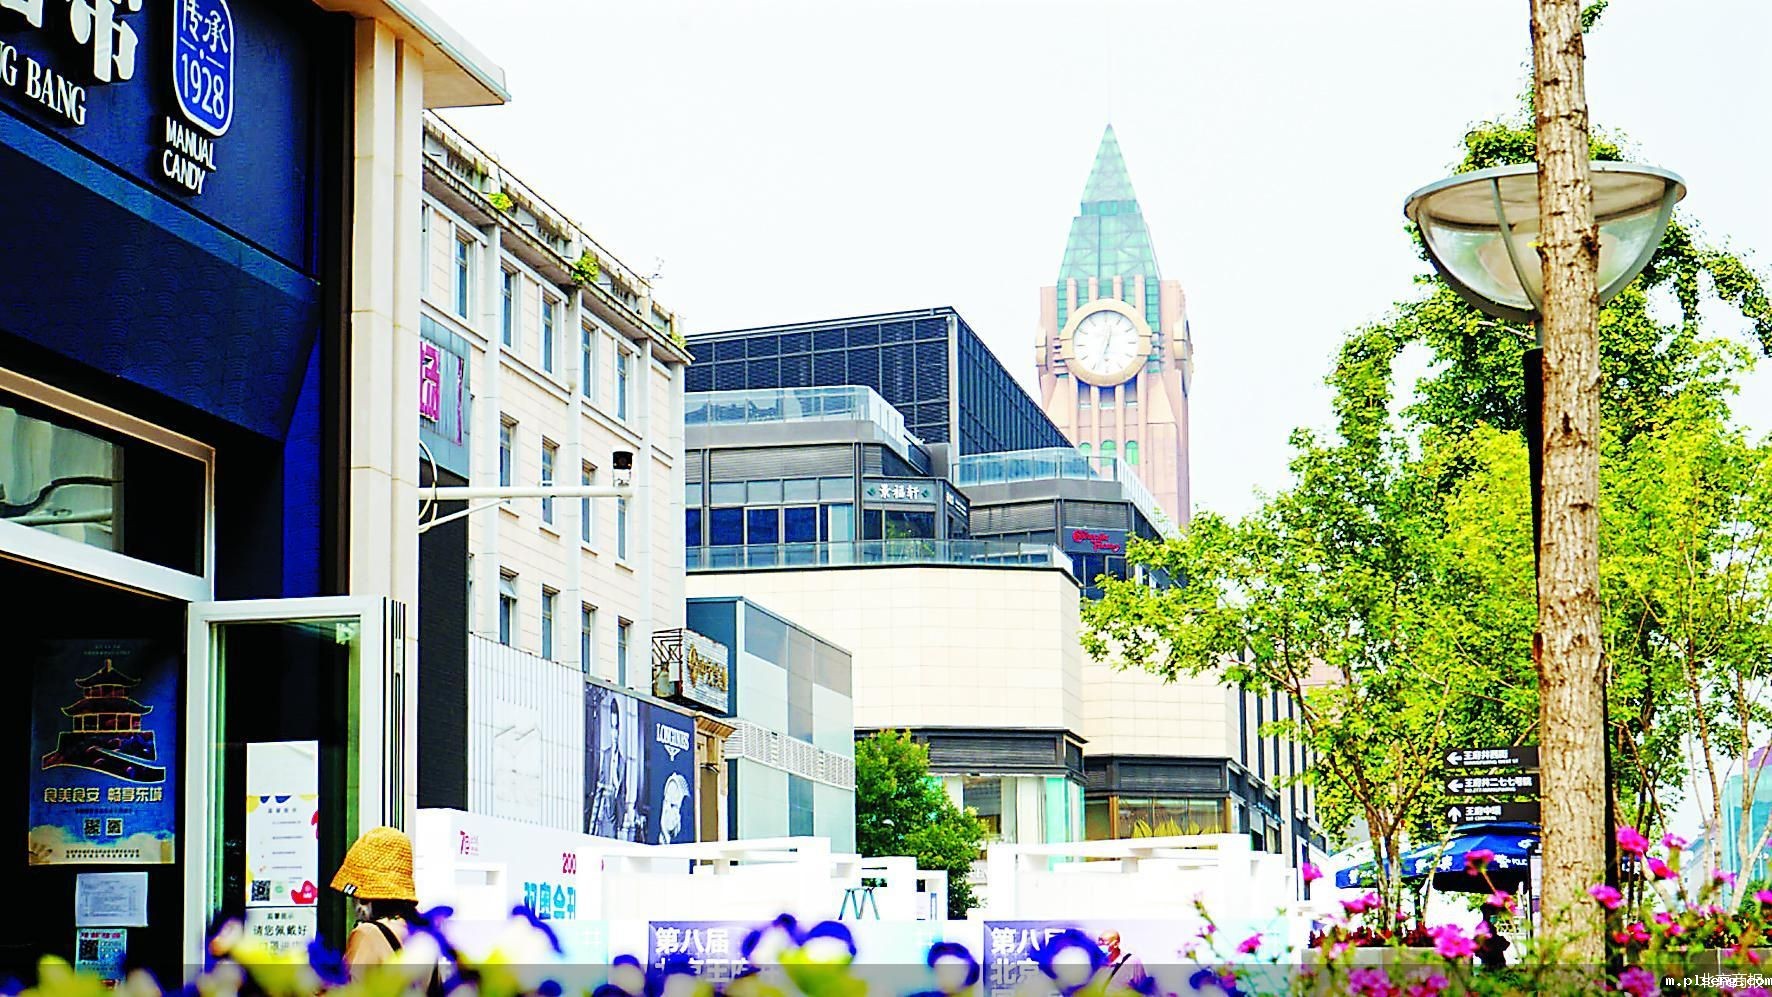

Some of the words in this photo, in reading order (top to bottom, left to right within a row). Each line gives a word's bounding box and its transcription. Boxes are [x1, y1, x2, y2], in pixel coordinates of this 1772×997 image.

[182, 0, 229, 54] 传承
[25, 57, 87, 126] BANG
[181, 53, 225, 120] 1928
[166, 116, 217, 171] MANUAL
[163, 150, 206, 195] CANDY
[656, 723, 690, 751] LONGINES
[656, 927, 729, 954] 第八届
